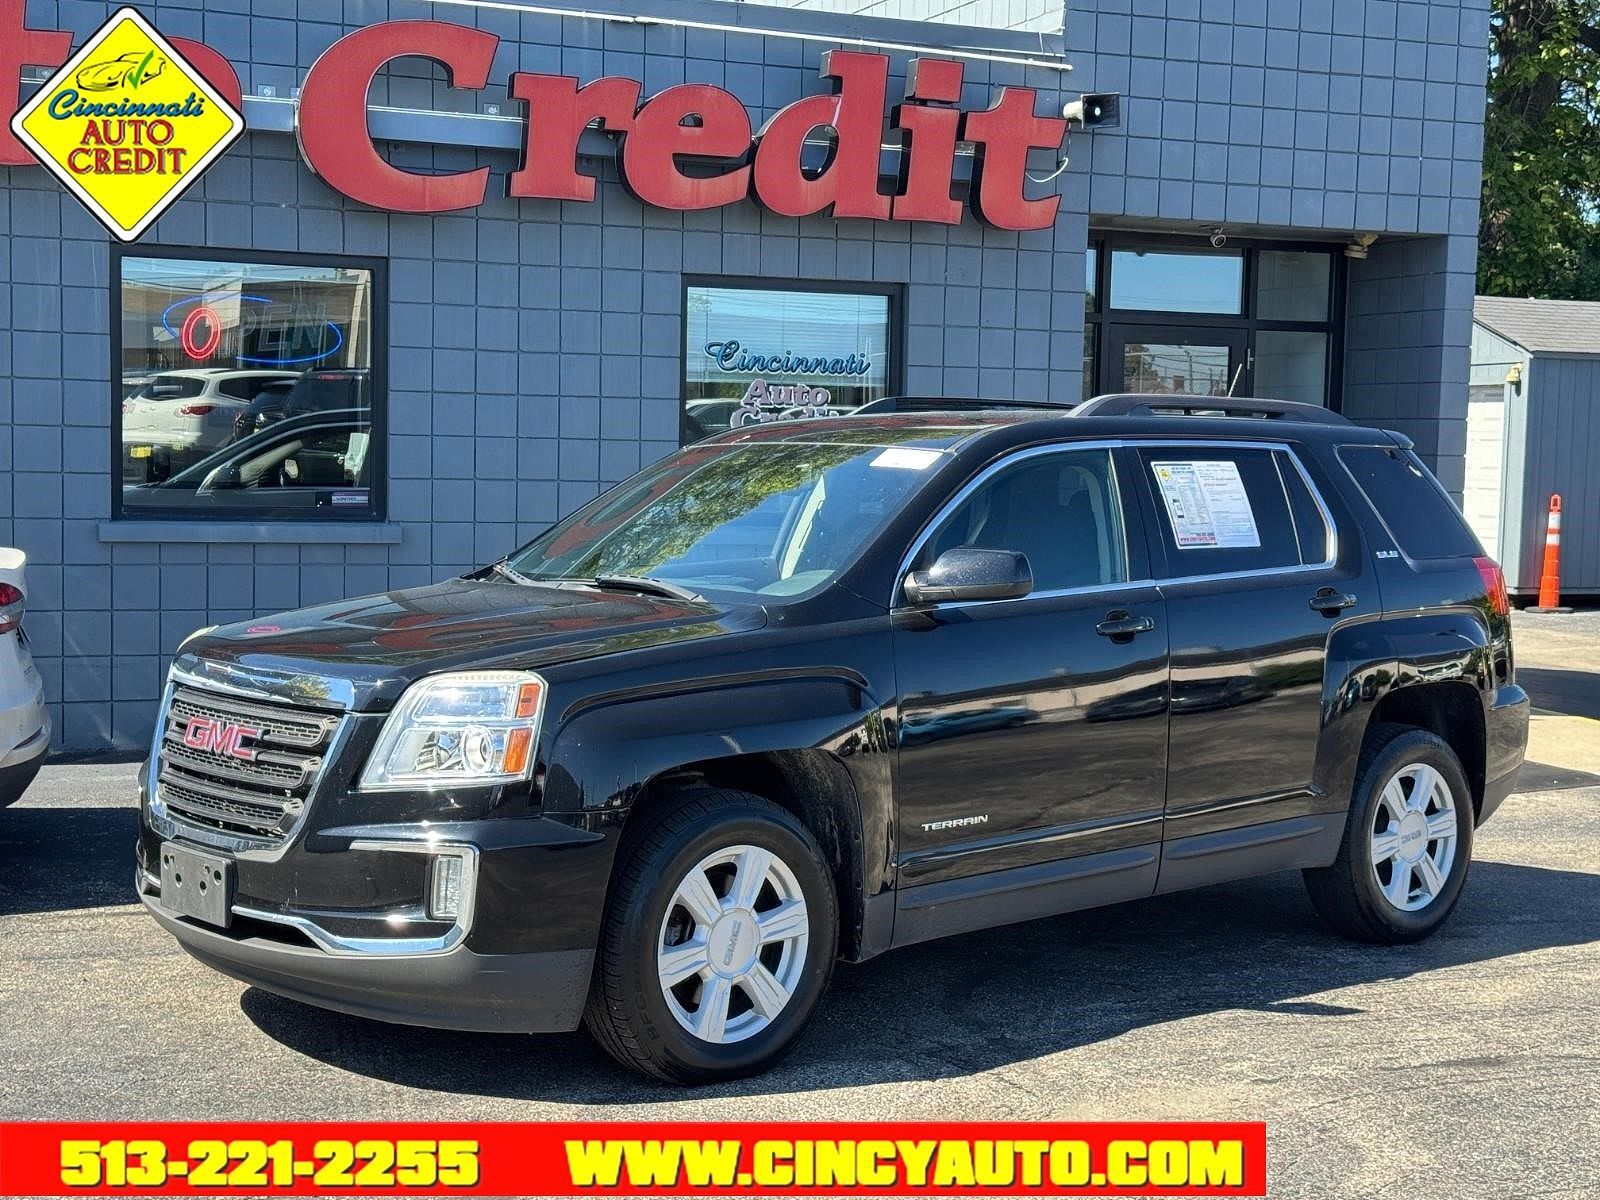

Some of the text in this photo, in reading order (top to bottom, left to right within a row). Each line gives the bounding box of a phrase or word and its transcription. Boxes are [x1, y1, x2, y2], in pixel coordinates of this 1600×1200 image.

[298, 20, 1065, 231] Credit
[705, 340, 871, 376] Cincinnati
[741, 379, 831, 407] Auto
[184, 716, 262, 762] GMC
[921, 814, 988, 832] TERRAIN
[723, 920, 742, 966] GMC
